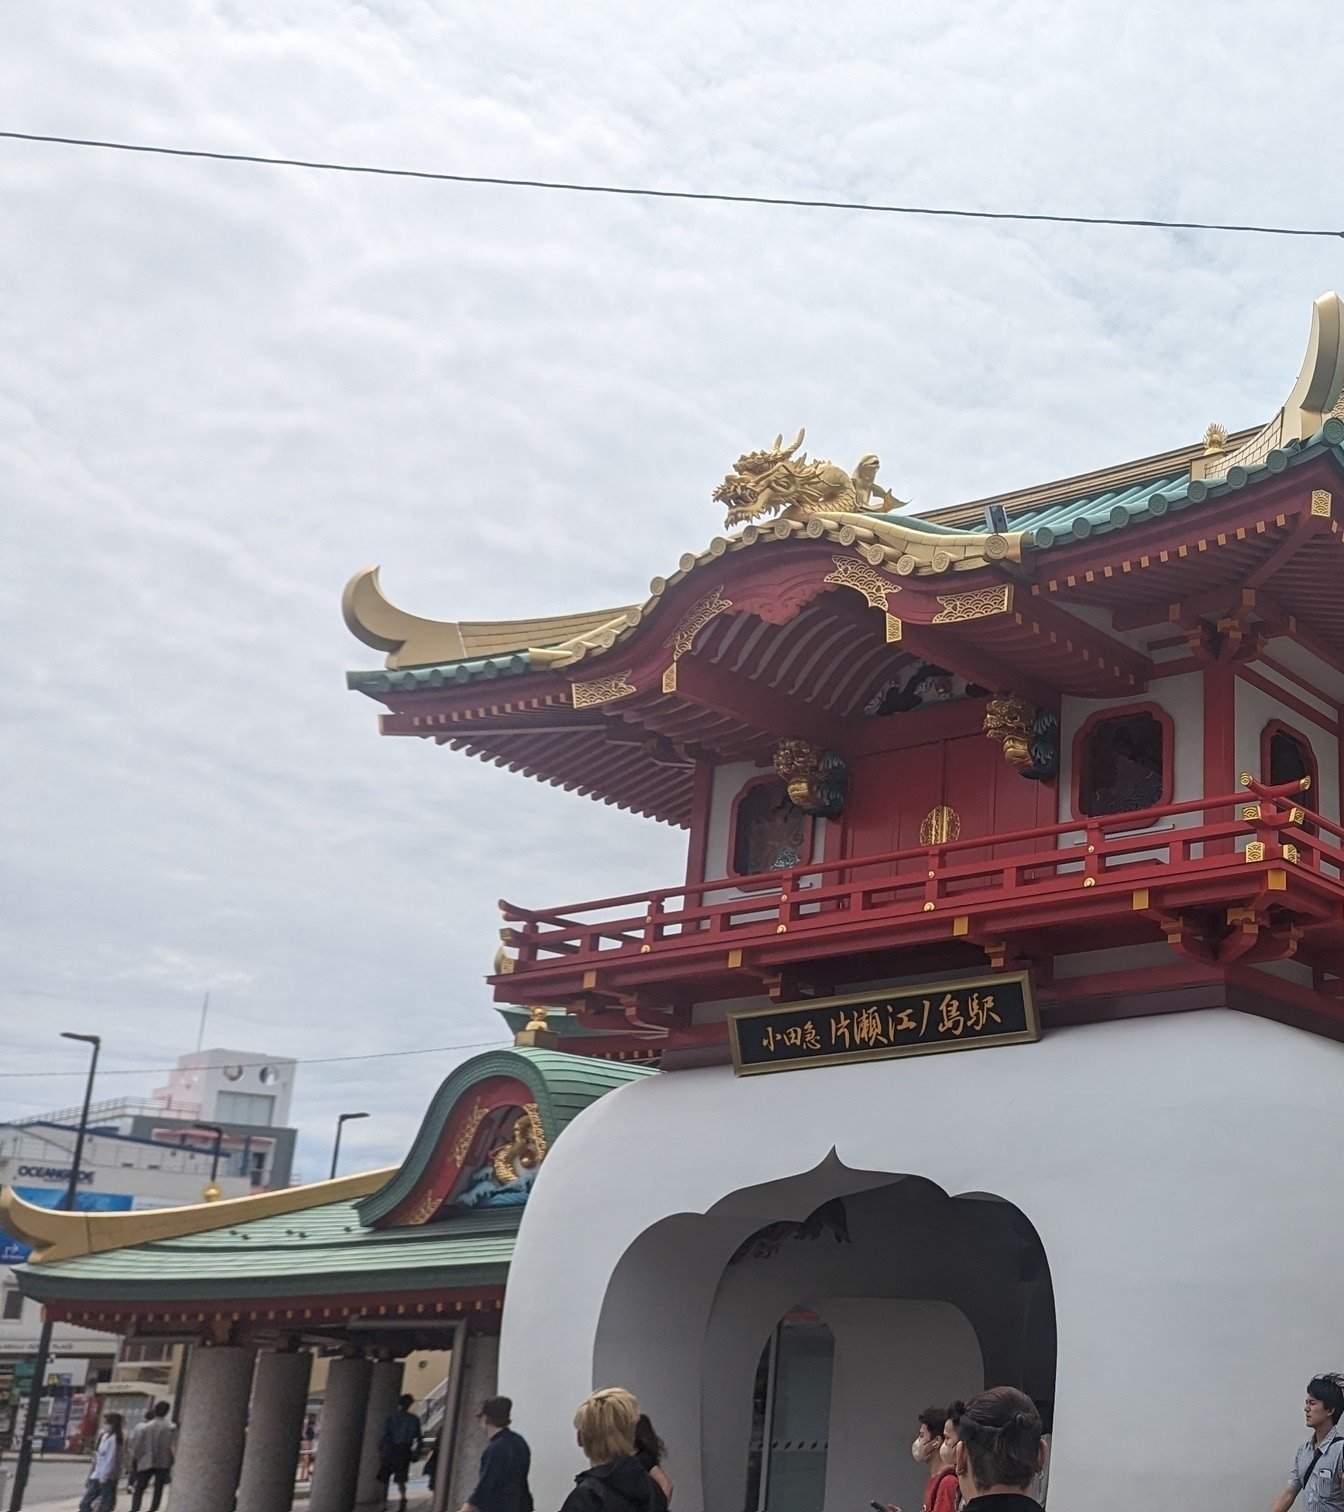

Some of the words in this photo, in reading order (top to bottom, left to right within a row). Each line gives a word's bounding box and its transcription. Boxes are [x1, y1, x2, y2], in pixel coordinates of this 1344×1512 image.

[762, 1020, 822, 1052] 小田急
[831, 992, 1002, 1049] 片瀬江ノ島駅
